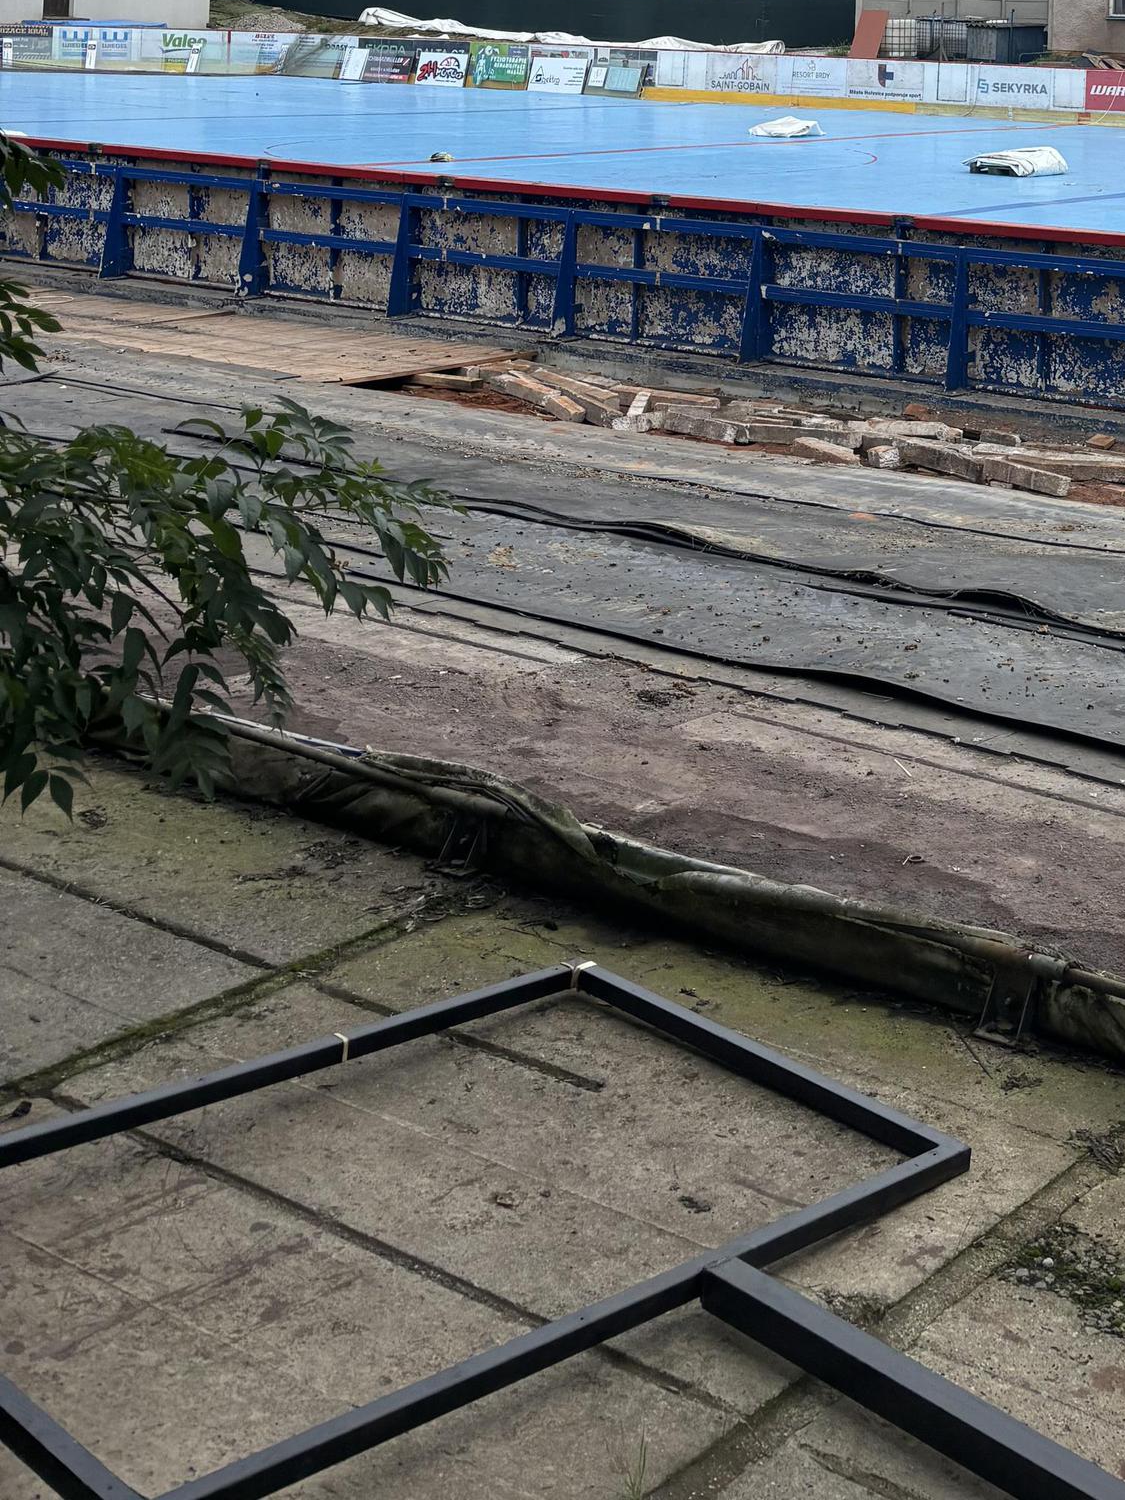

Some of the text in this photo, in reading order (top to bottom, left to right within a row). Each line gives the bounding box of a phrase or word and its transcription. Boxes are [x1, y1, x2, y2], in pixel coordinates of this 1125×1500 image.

[793, 71, 815, 79] RESORT
[711, 79, 770, 91] SAINT-GOBAIN
[992, 82, 1048, 95] SEKYRKA
